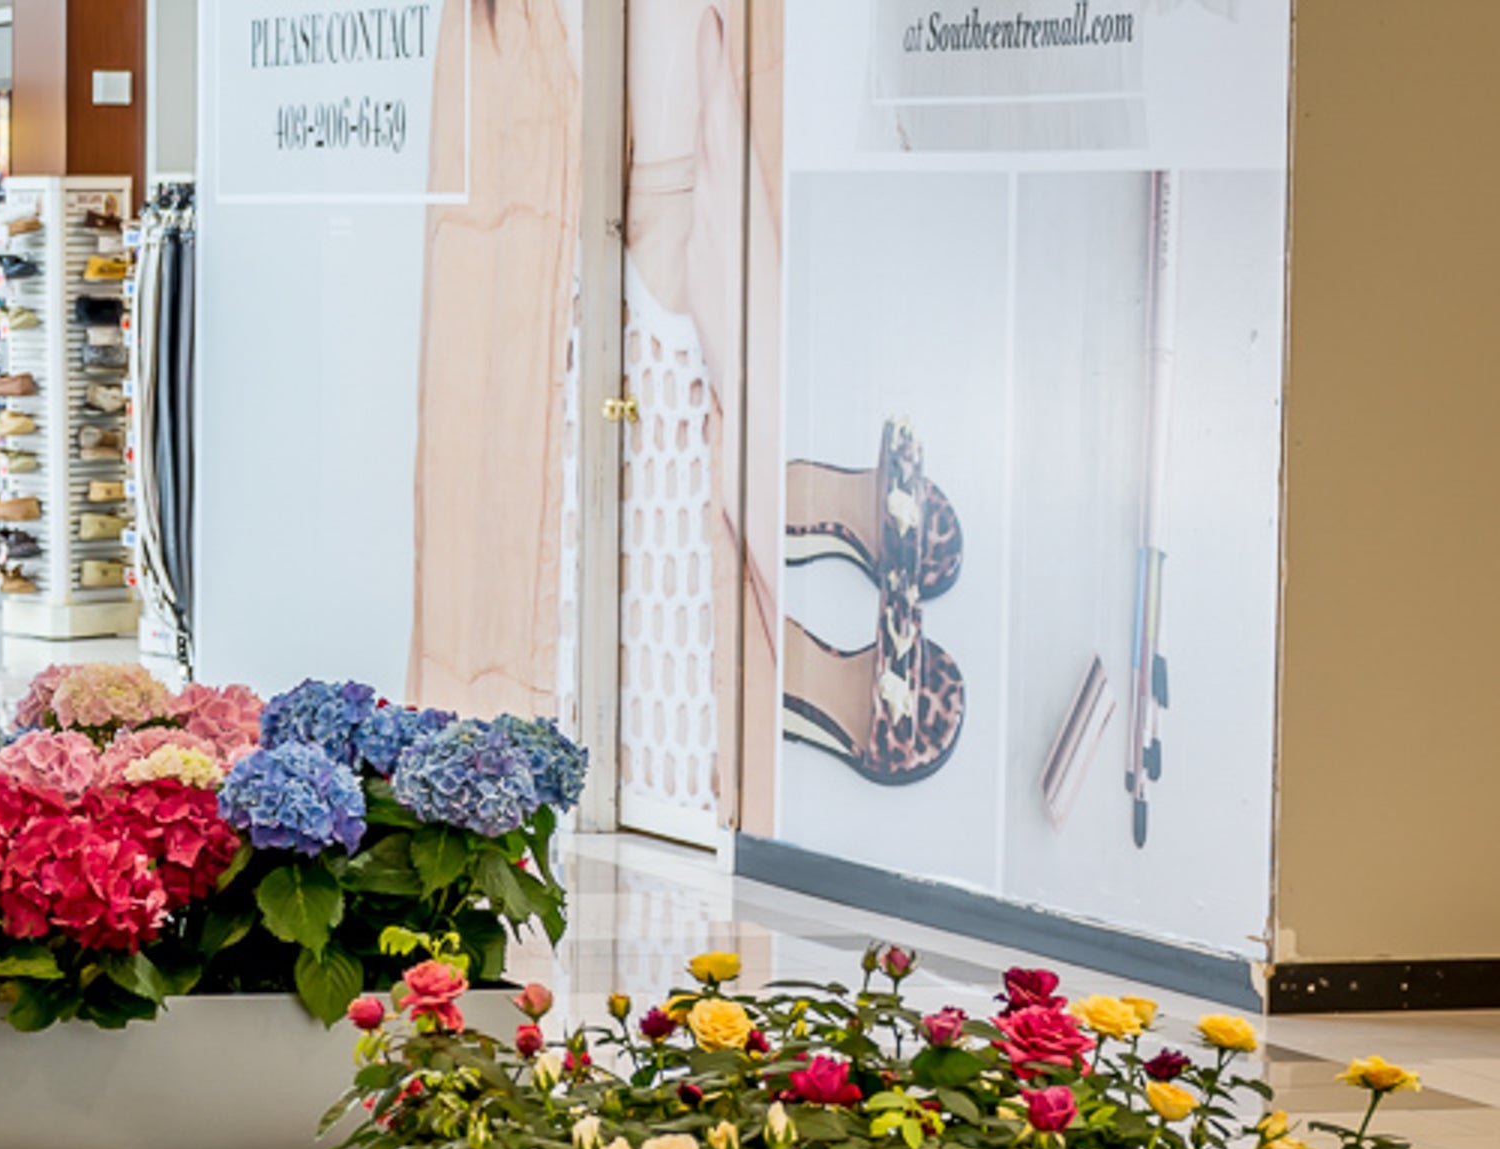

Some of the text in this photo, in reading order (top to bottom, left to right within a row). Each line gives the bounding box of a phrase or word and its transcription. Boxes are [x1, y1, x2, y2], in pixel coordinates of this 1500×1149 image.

[251, 5, 430, 68] PLEASE CONTACT
[904, 0, 1134, 53] at Southcentremall.com
